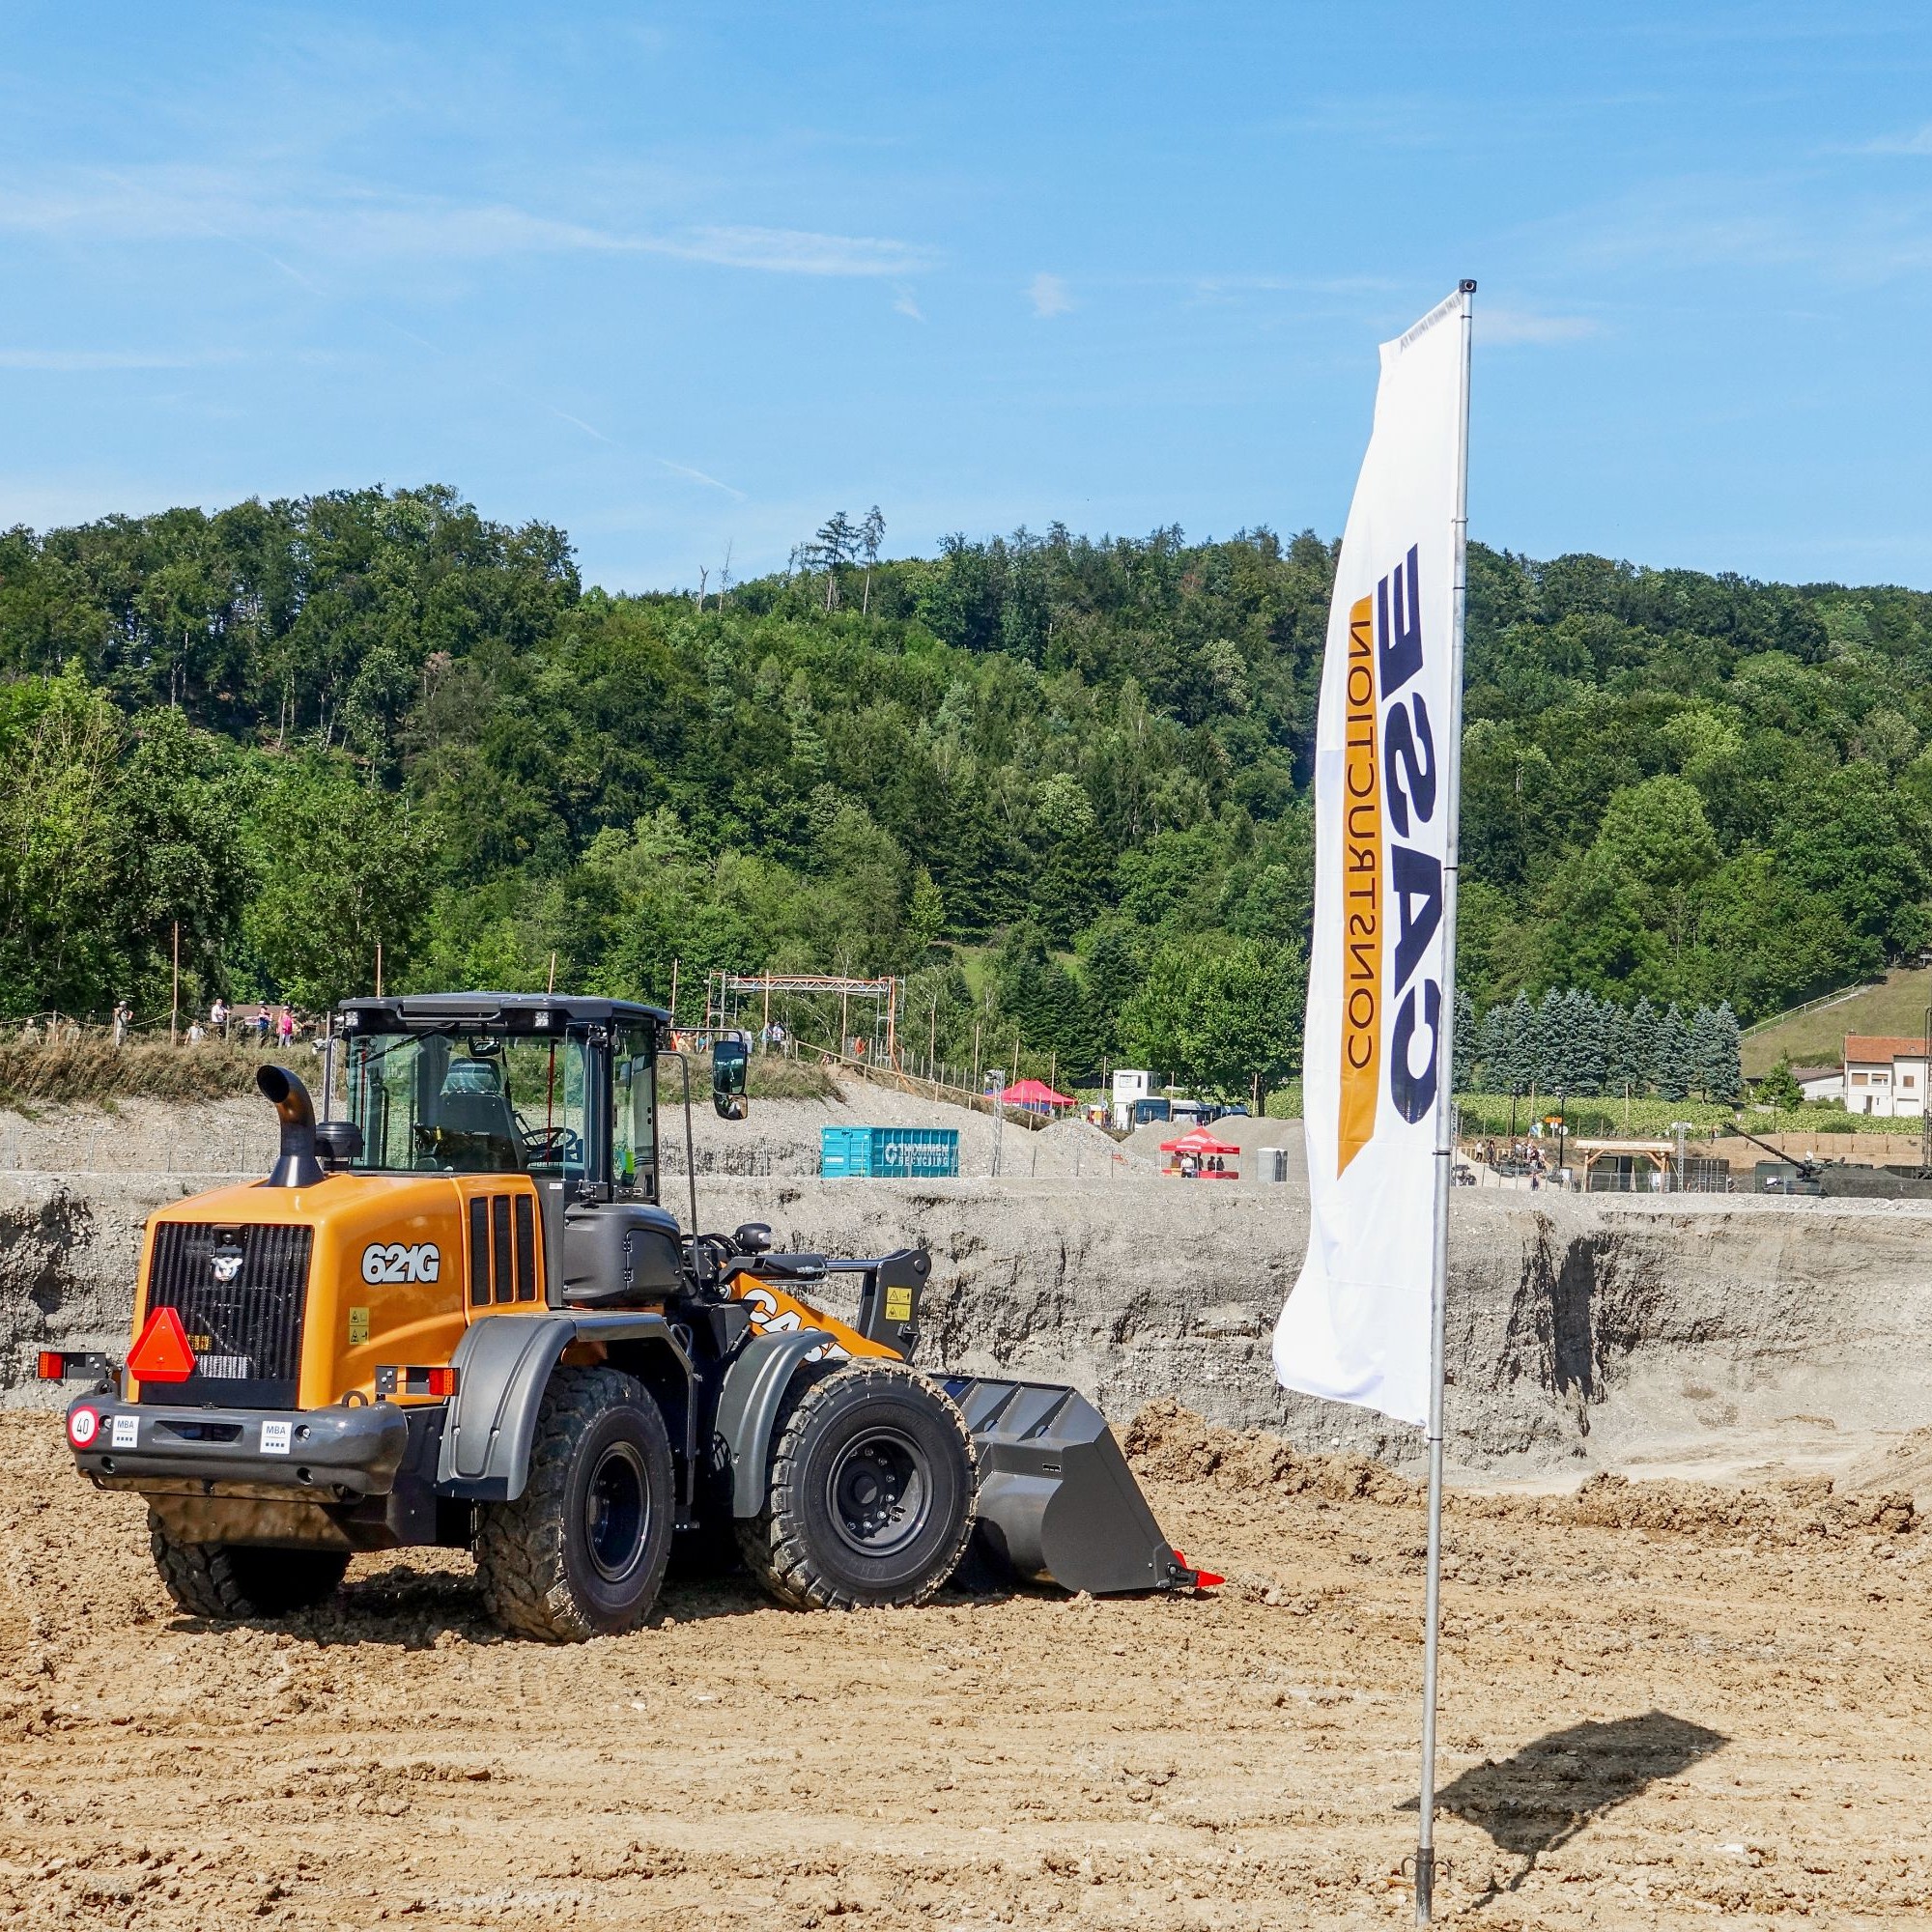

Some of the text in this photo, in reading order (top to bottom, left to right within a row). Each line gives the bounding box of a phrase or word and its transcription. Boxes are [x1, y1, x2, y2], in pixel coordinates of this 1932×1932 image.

[898, 1156, 949, 1165] RECYCLING
[361, 1242, 440, 1286] 621G
[743, 1288, 852, 1362] CA
[76, 1417, 90, 1435] 40
[117, 1419, 134, 1429] MBA
[266, 1425, 286, 1435] MBA
